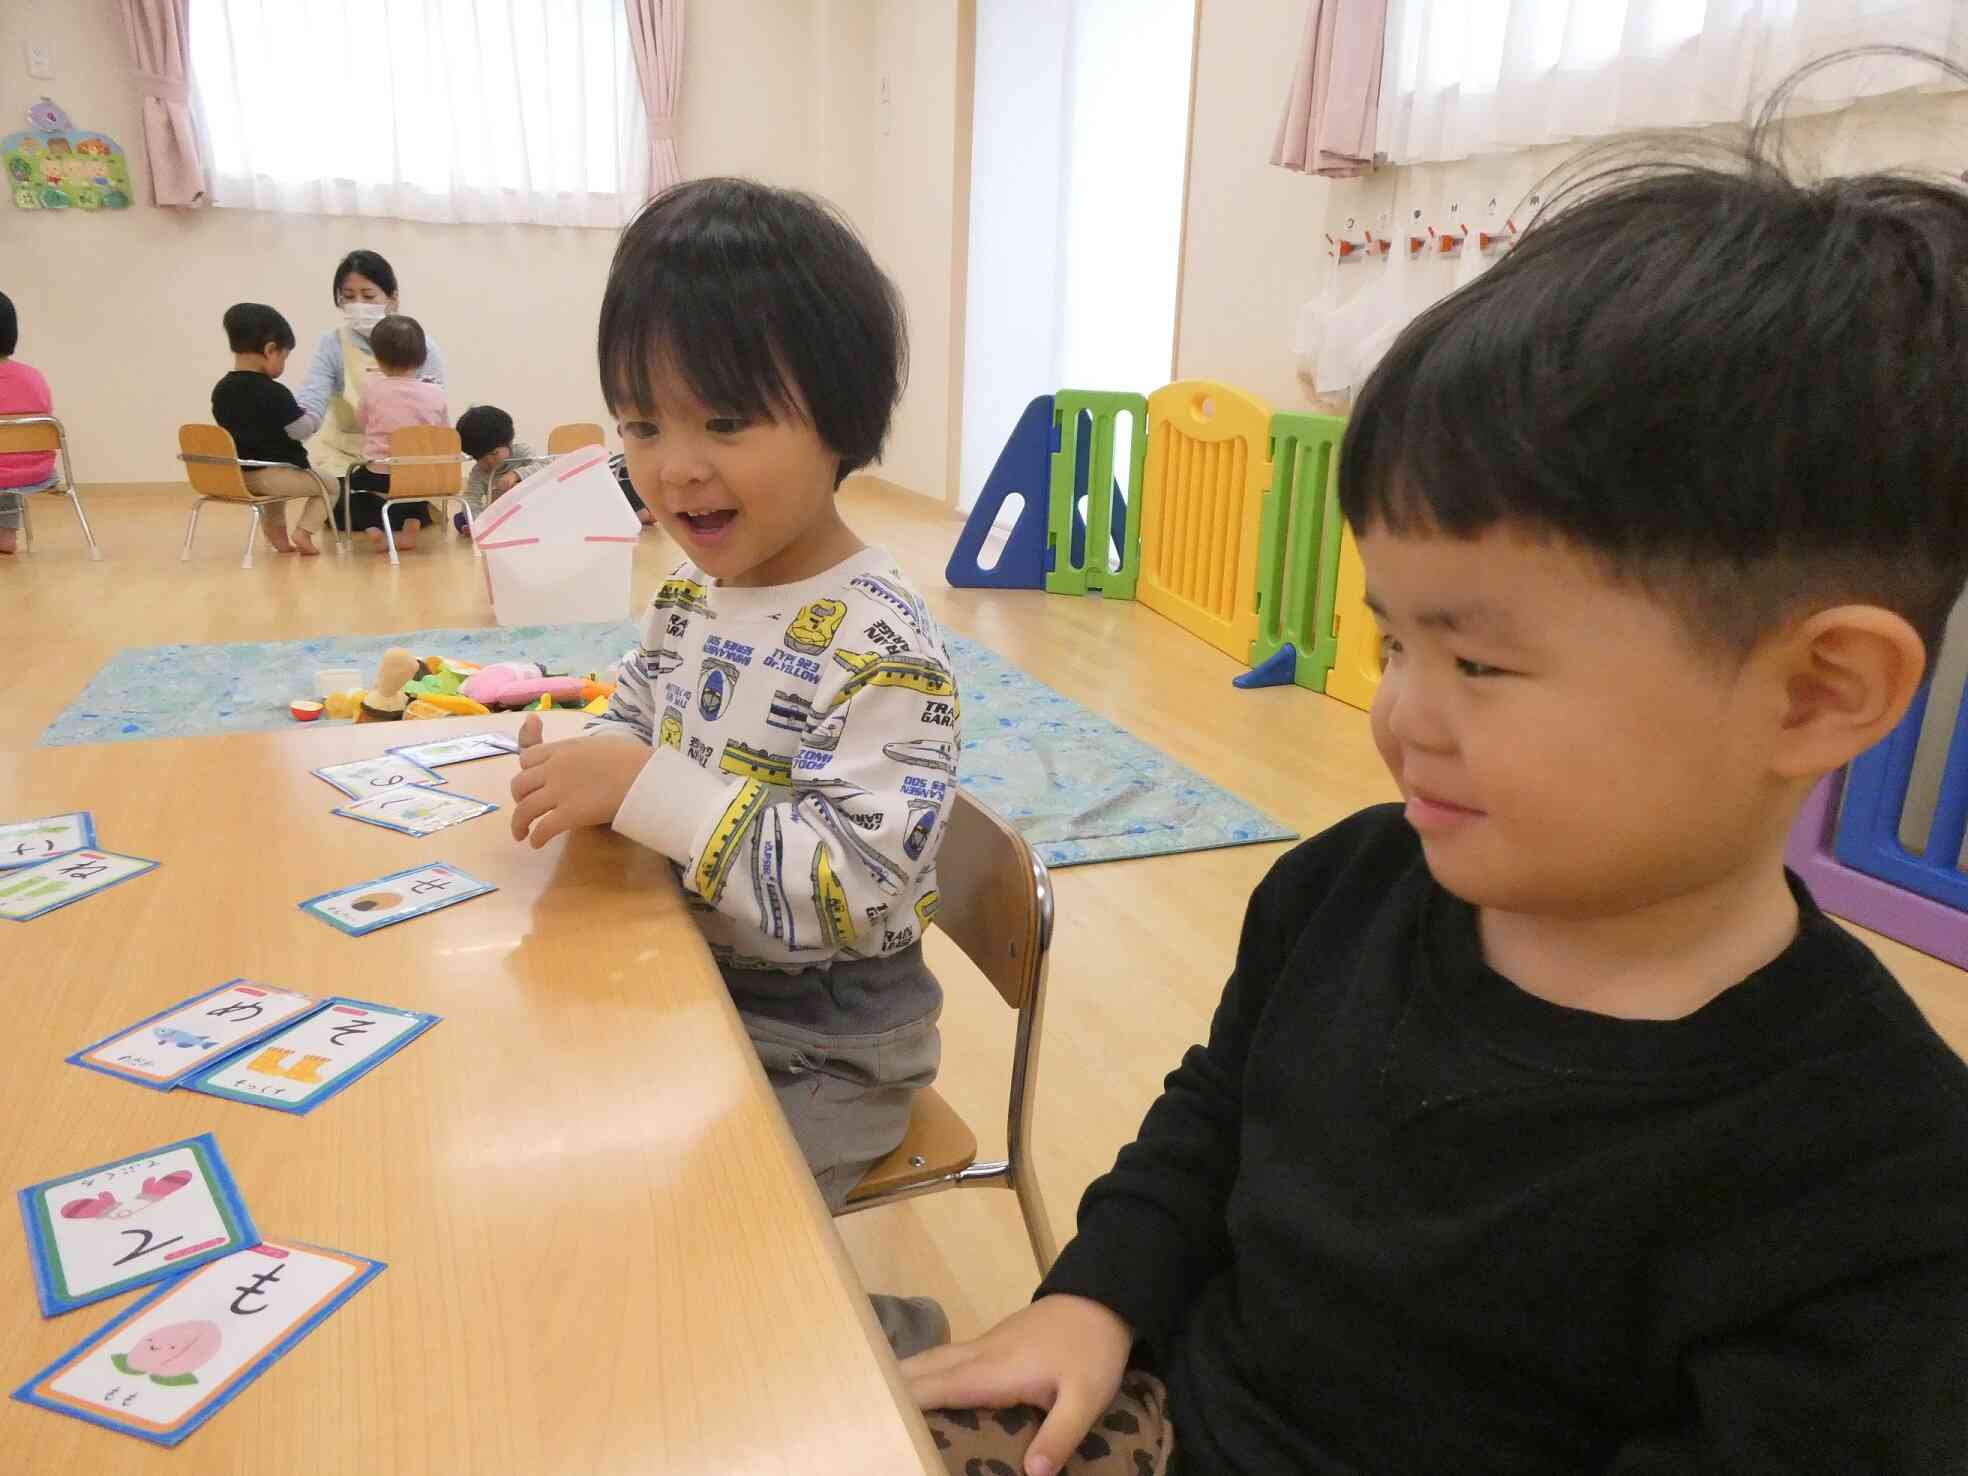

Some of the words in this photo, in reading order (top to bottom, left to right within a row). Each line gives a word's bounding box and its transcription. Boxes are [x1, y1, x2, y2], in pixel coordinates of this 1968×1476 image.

[56, 860, 108, 879] ね
[411, 878, 452, 895] せ
[206, 1001, 263, 1023] め
[329, 1019, 376, 1046] そ
[112, 1229, 184, 1267] て
[229, 1263, 286, 1315] も
[104, 1385, 138, 1407] もも
